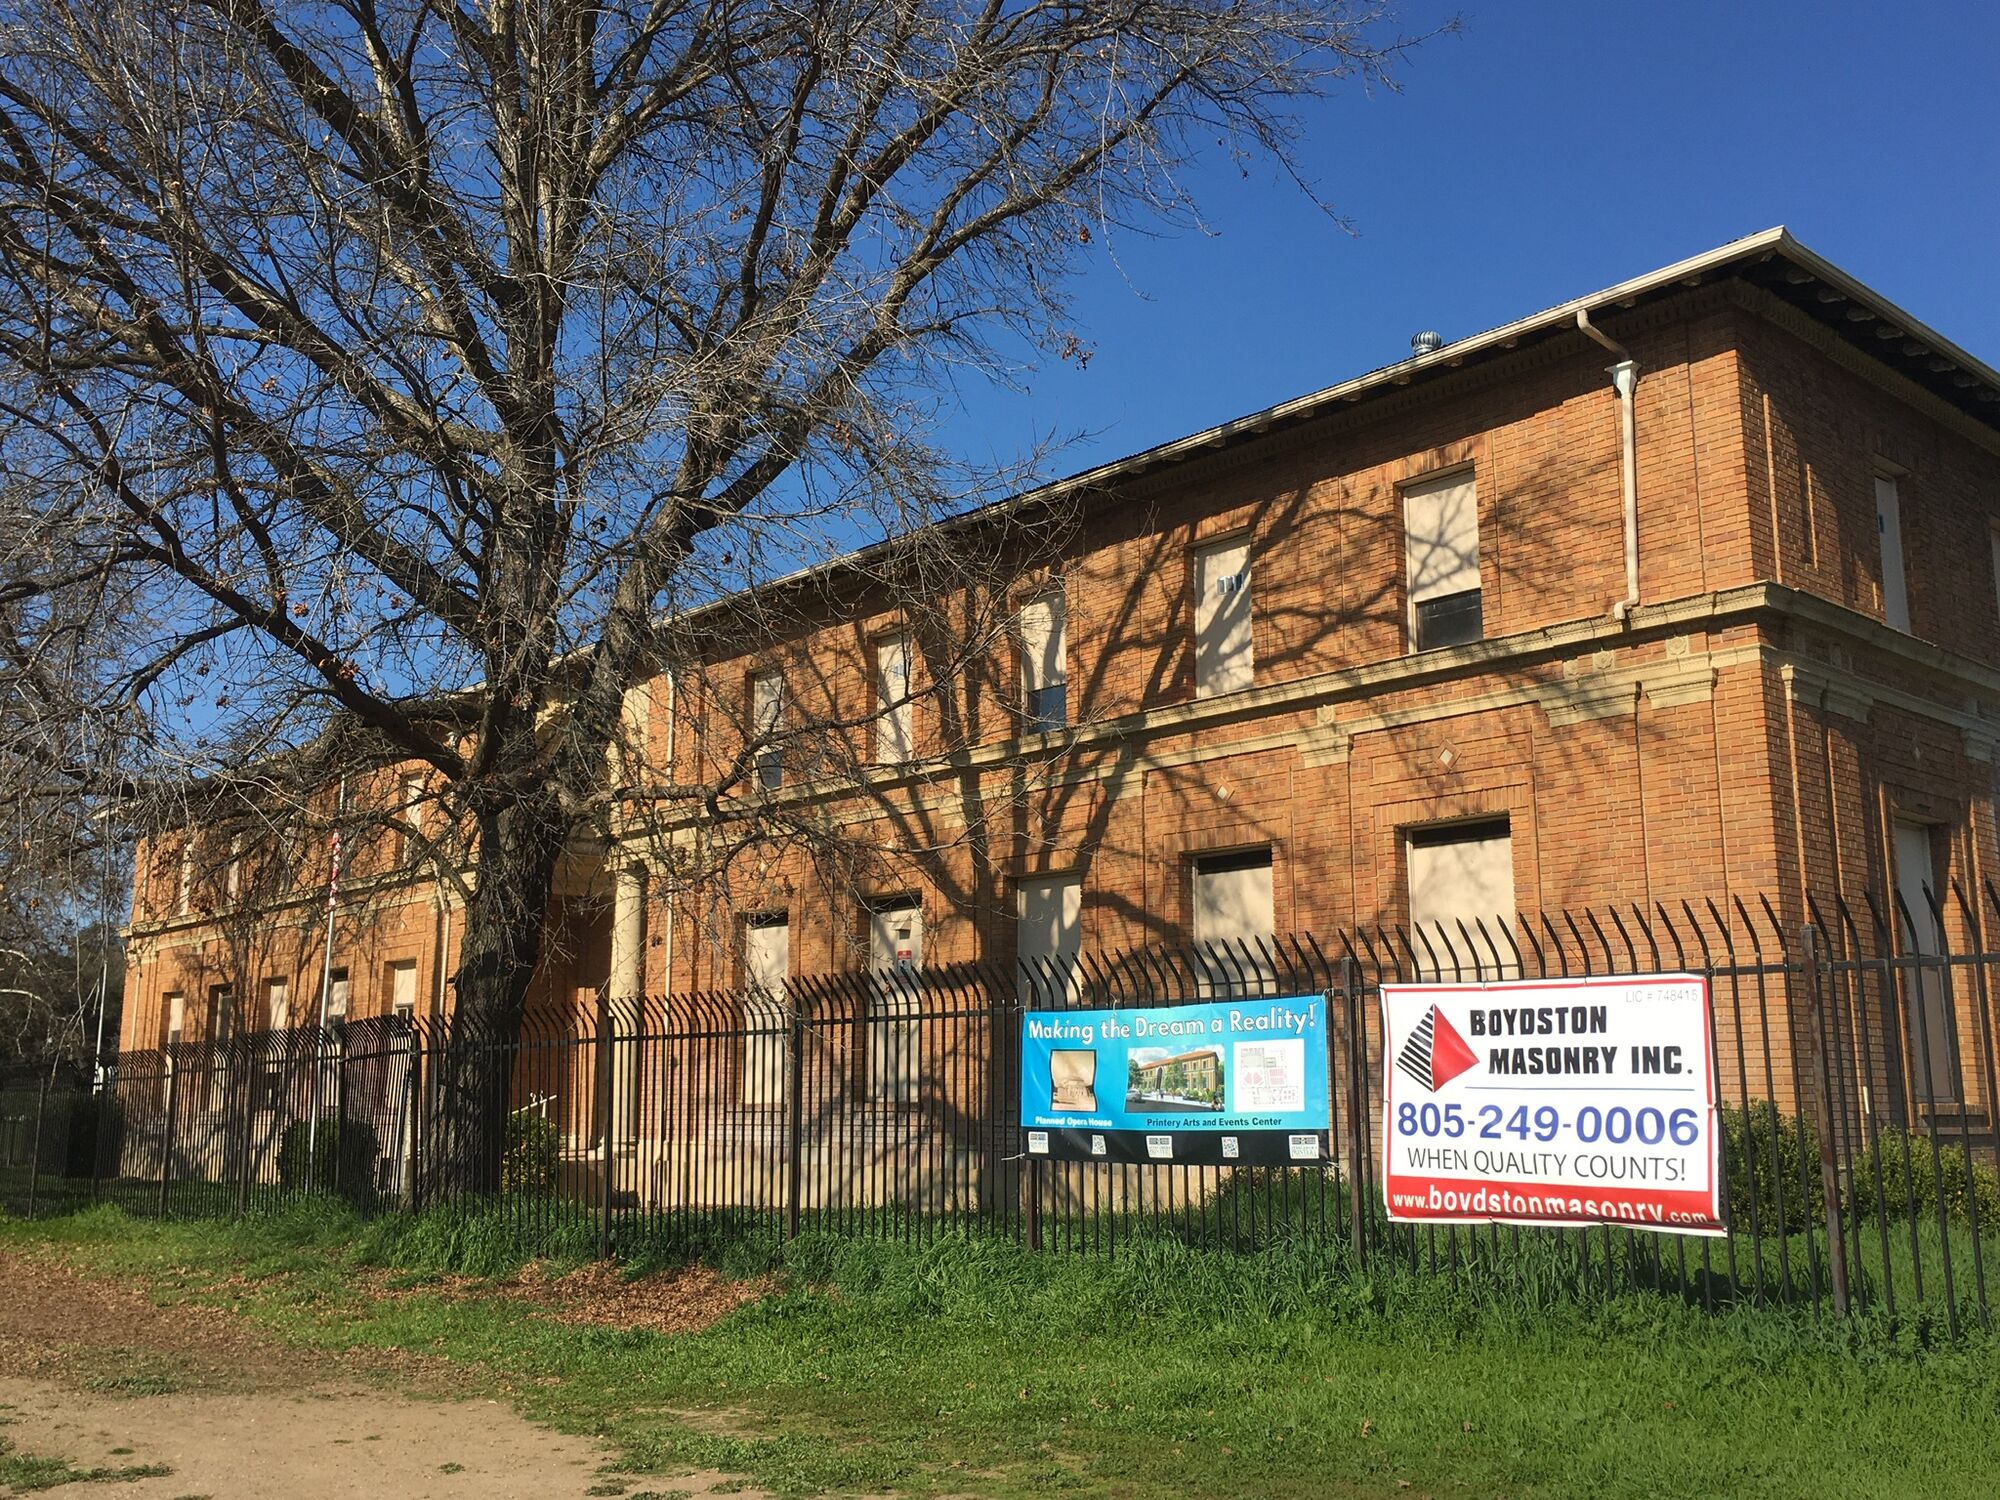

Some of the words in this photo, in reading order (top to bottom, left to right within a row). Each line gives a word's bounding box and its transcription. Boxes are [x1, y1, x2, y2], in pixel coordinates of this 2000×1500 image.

[1625, 990, 1643, 1003] LIC
[1028, 1018, 1094, 1045] Making
[1101, 1017, 1130, 1039] the
[1135, 1016, 1205, 1038] Dream
[1210, 1018, 1223, 1033] a
[1229, 1004, 1317, 1035] Reality!
[1470, 1005, 1607, 1037] BOYDSTON
[1488, 1046, 1618, 1075] MASONRY
[1631, 1045, 1693, 1075] INC.
[1089, 1117, 1113, 1128] House
[1146, 1118, 1181, 1128] Printery
[1183, 1117, 1200, 1127] Arts
[1202, 1117, 1217, 1127] and
[1218, 1117, 1249, 1127] Events
[1252, 1117, 1282, 1126] Center
[1398, 1102, 1699, 1146] 805-249-0006
[1408, 1147, 1468, 1171] WHEN
[1474, 1150, 1567, 1176] QUALITY
[1574, 1154, 1686, 1182] COUNTS!
